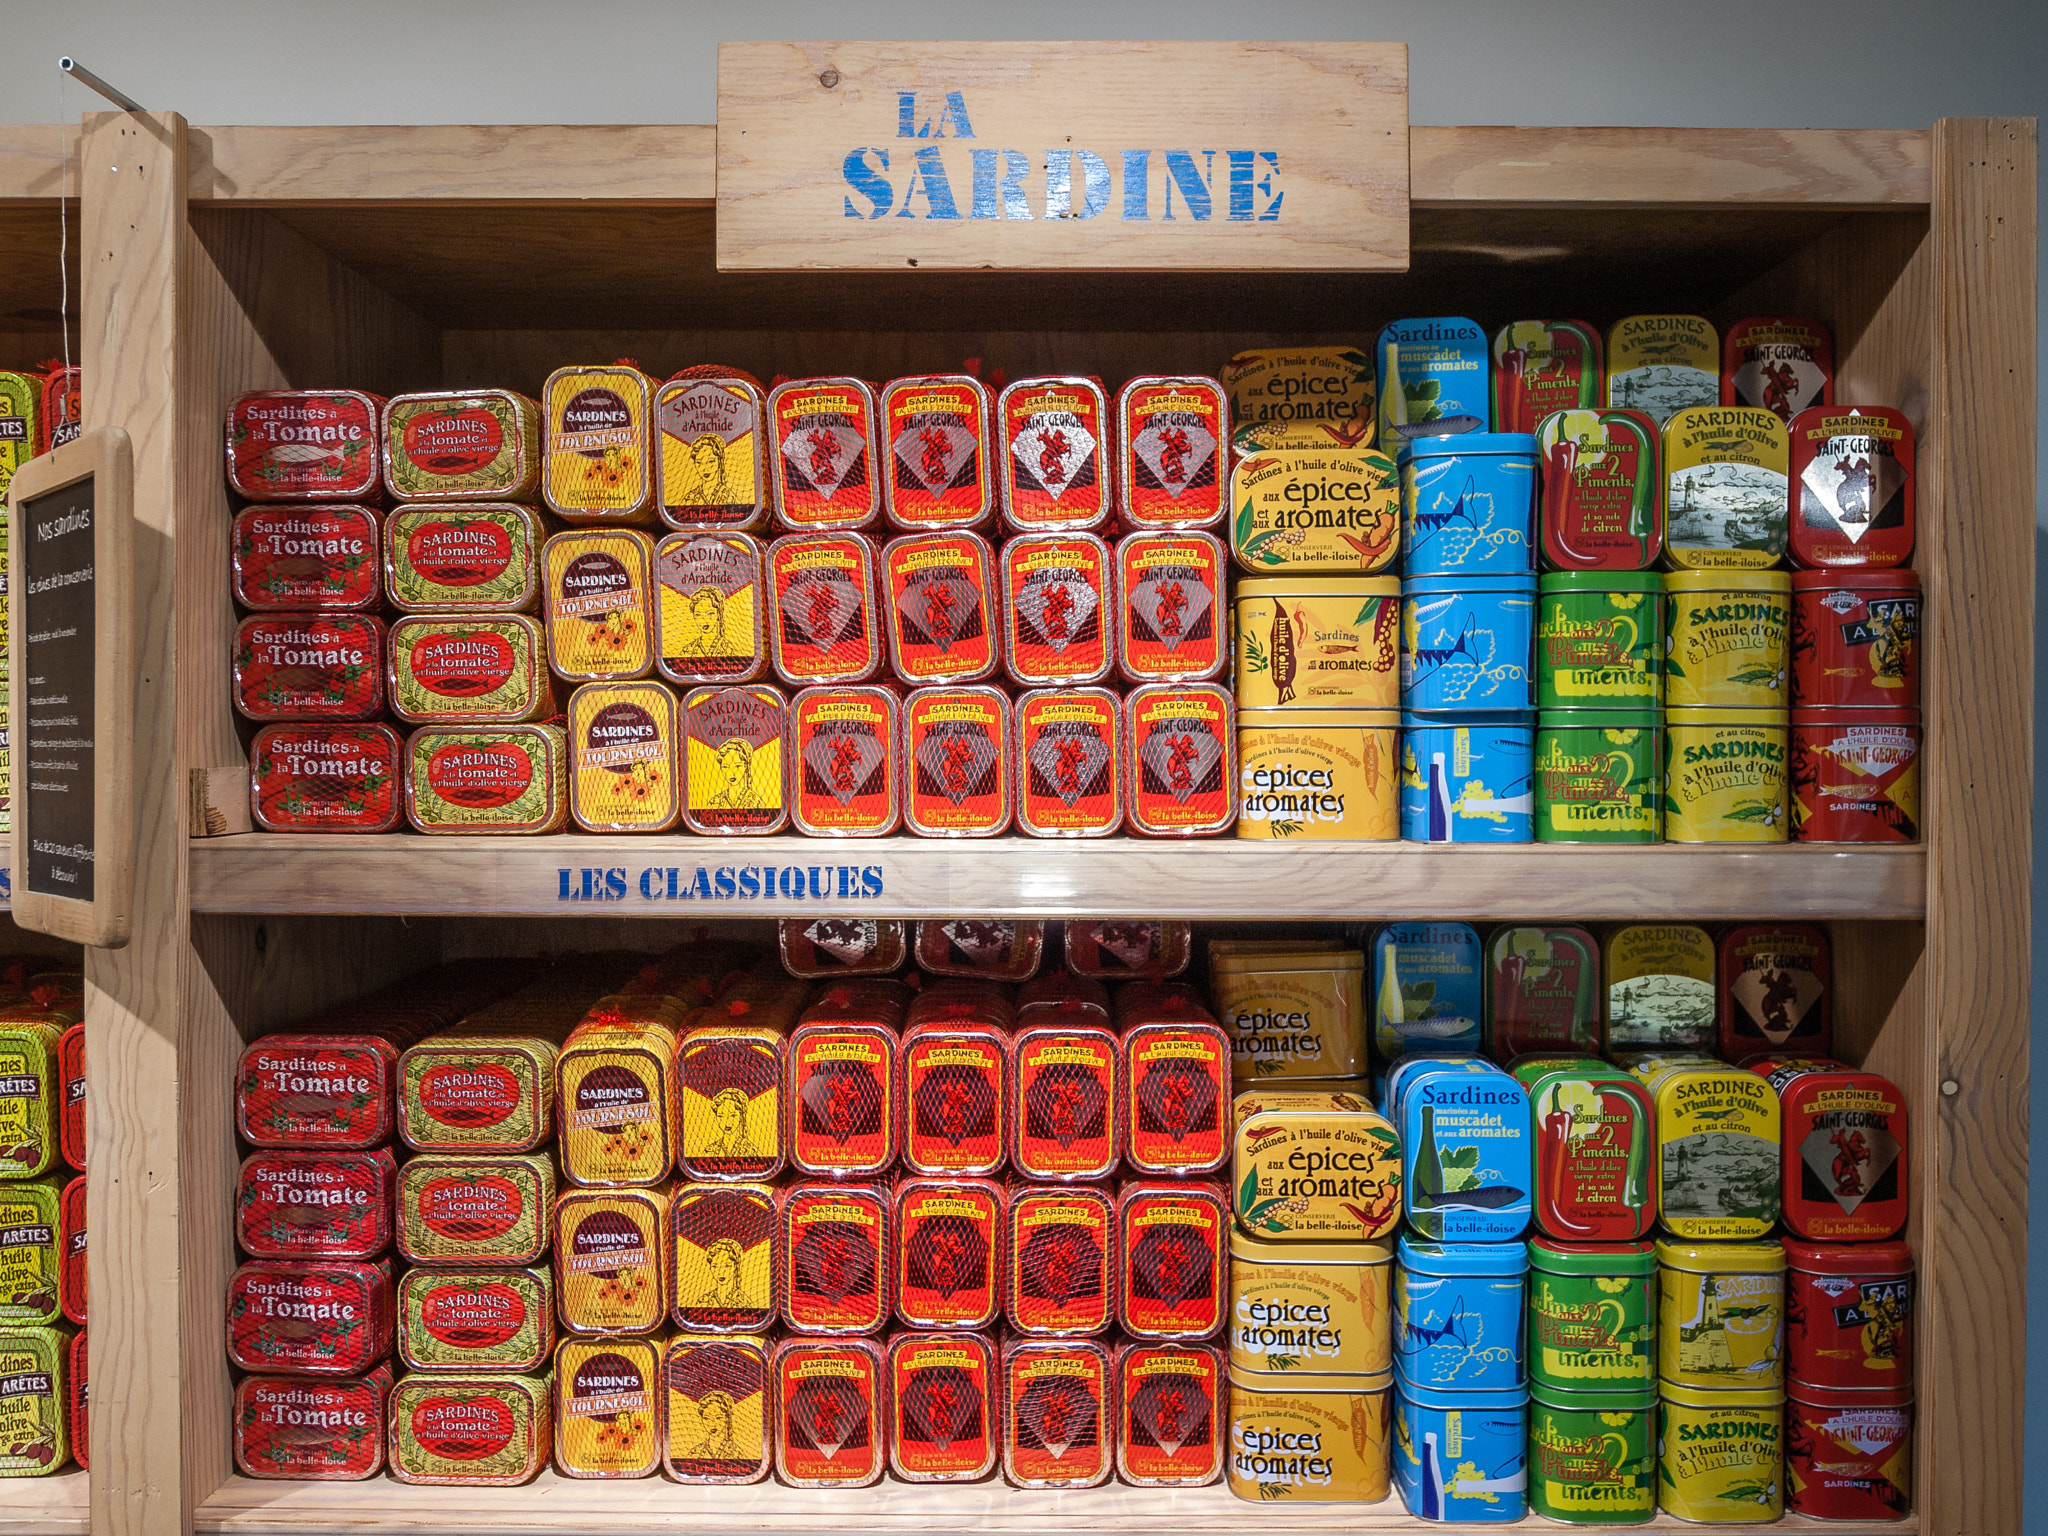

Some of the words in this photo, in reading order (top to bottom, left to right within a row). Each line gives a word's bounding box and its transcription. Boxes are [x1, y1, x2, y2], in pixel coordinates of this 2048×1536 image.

[896, 91, 977, 138] LA
[843, 145, 1285, 221] SARDINE
[1387, 324, 1478, 344] Sardines
[1623, 318, 1705, 337] SARDINES
[1401, 349, 1461, 362] muscadet
[1422, 360, 1478, 372] aromates
[1555, 360, 1566, 378] 2
[1267, 373, 1348, 401] épices
[673, 395, 740, 417] SARDINES
[797, 397, 844, 406] SARDINES
[908, 396, 957, 405] SARDINES
[1027, 397, 1076, 405] SARDINES
[1150, 396, 1198, 404] SARDINES
[247, 407, 326, 422] Sardines
[567, 411, 627, 422] SARDINES
[1259, 400, 1358, 421] aromates
[417, 421, 487, 437] SARDINES
[1686, 412, 1776, 431] SARDINES
[1824, 418, 1885, 427] SARDINES
[263, 421, 362, 443] Tomate
[558, 430, 634, 449] TOURNESOL
[1693, 427, 1733, 446] l'huile
[1735, 428, 1779, 449] d'Olive
[1821, 428, 1858, 436] L'HUILE
[1860, 428, 1897, 437] D'OLIVE
[432, 435, 479, 445] tomate
[1578, 434, 1633, 453] Sardines
[1608, 454, 1619, 477] 2
[1730, 453, 1761, 465] citron
[1241, 466, 1282, 489] Sardines
[1295, 460, 1327, 471] l'huile
[1330, 460, 1363, 475] d'olive
[1284, 477, 1371, 508] épices
[1275, 506, 1381, 530] aromates
[253, 520, 327, 535] Sardines
[1593, 522, 1622, 533] citron
[268, 535, 363, 558] Tomate
[423, 532, 497, 548] SARDINES
[438, 546, 487, 556] tomate
[671, 547, 740, 568] SARDINES
[794, 552, 842, 561] SARDINES
[909, 550, 958, 561] SARDINES
[1030, 552, 1079, 561] SARDINES
[1292, 551, 1301, 561] la
[1304, 551, 1359, 562] belle-iloise
[1703, 557, 1712, 567] la
[1714, 557, 1768, 567] belle-iloise
[565, 574, 626, 587] SARDINES
[558, 593, 635, 614] TOURNESOL
[1689, 603, 1789, 627] SARDINES
[253, 631, 330, 646] Sardines
[1314, 630, 1359, 642] Sardines
[268, 646, 363, 668] Tomate
[426, 643, 499, 659] SARDINES
[440, 657, 490, 667] tomate
[1318, 658, 1373, 672] aromates
[932, 705, 981, 713] SARDINES
[1156, 703, 1204, 711] SARDINES
[592, 725, 653, 738] SARDINES
[271, 740, 349, 755] Sardines
[585, 746, 662, 764] TOURNESOL
[1684, 740, 1784, 764] SARDINES
[287, 755, 383, 778] Tomate
[443, 754, 517, 769] SARDINES
[458, 768, 508, 778] tomate
[1253, 763, 1334, 792] épices
[1246, 792, 1344, 814] aromates
[1829, 803, 1877, 811] SARDINES
[557, 867, 627, 900] LES
[640, 864, 884, 900] CLASSIQUES
[1386, 927, 1473, 945] Sardines
[1398, 951, 1457, 964] muscadet
[1418, 963, 1472, 974] aromates
[1236, 1008, 1310, 1033] épices
[818, 1044, 867, 1054] SARDINES
[1153, 1042, 1201, 1051] SARDINES
[258, 1057, 336, 1073] Sardines
[273, 1072, 370, 1095] Tomate
[433, 1074, 505, 1090] SARDINES
[448, 1089, 496, 1099] tomate
[580, 1088, 643, 1100] SARDINES
[1422, 1085, 1520, 1105] Sardines
[1676, 1080, 1766, 1100] SARDINES
[1821, 1091, 1880, 1101] SARDINES
[1572, 1104, 1628, 1124] Sardines
[1683, 1097, 1724, 1113] l'huile
[1726, 1096, 1769, 1117] d'Olive
[1818, 1102, 1853, 1110] L'HUILE
[1856, 1102, 1891, 1111] D'OLIVE
[574, 1106, 652, 1125] TOURNESOL
[1436, 1113, 1502, 1126] muscadet
[1459, 1127, 1520, 1138] aromates
[1721, 1120, 1751, 1133] citron
[1246, 1133, 1287, 1157] Sardines
[1300, 1128, 1331, 1140] l'huile
[1335, 1129, 1367, 1145] d'olive
[1602, 1125, 1615, 1147] 2
[1288, 1147, 1375, 1178] épices
[257, 1168, 333, 1184] Sardines
[434, 1186, 507, 1201] SARDINES
[1278, 1175, 1386, 1199] aromates
[273, 1184, 367, 1206] Tomate
[1588, 1193, 1617, 1203] citron
[449, 1201, 498, 1211] tomate
[924, 1200, 973, 1210] SARDINES
[1295, 1221, 1304, 1230] la
[1307, 1221, 1362, 1231] belle-iloise
[1444, 1223, 1453, 1233] la
[1456, 1223, 1516, 1233] belle-iloise
[1698, 1226, 1707, 1235] la
[1709, 1226, 1761, 1235] belle-iloise
[1835, 1224, 1891, 1234] belle-iloise
[2, 1227, 49, 1244] ARÊTES
[578, 1233, 639, 1244] SARDINES
[570, 1252, 646, 1269] TOURNESOL
[247, 1280, 322, 1298] Sardines
[261, 1296, 354, 1322] Tomate
[436, 1294, 509, 1309] SARDINES
[451, 1309, 501, 1319] tomate
[1249, 1299, 1330, 1324] épices
[1242, 1325, 1341, 1348] aromates
[803, 1360, 852, 1369] SARDINES
[1147, 1358, 1195, 1367] SARDINES
[2, 1376, 48, 1394] ARÊTES
[578, 1376, 639, 1387] SARDINES
[256, 1389, 333, 1405] Sardines
[570, 1396, 646, 1413] TOURNESOL
[270, 1405, 366, 1427] Tomate
[426, 1406, 499, 1421] SARDINES
[441, 1421, 490, 1430] tomate
[1679, 1422, 1779, 1442] SARDINES
[1242, 1426, 1321, 1455] épices
[1236, 1451, 1332, 1477] aromates
[1824, 1480, 1871, 1488] SARDINES
